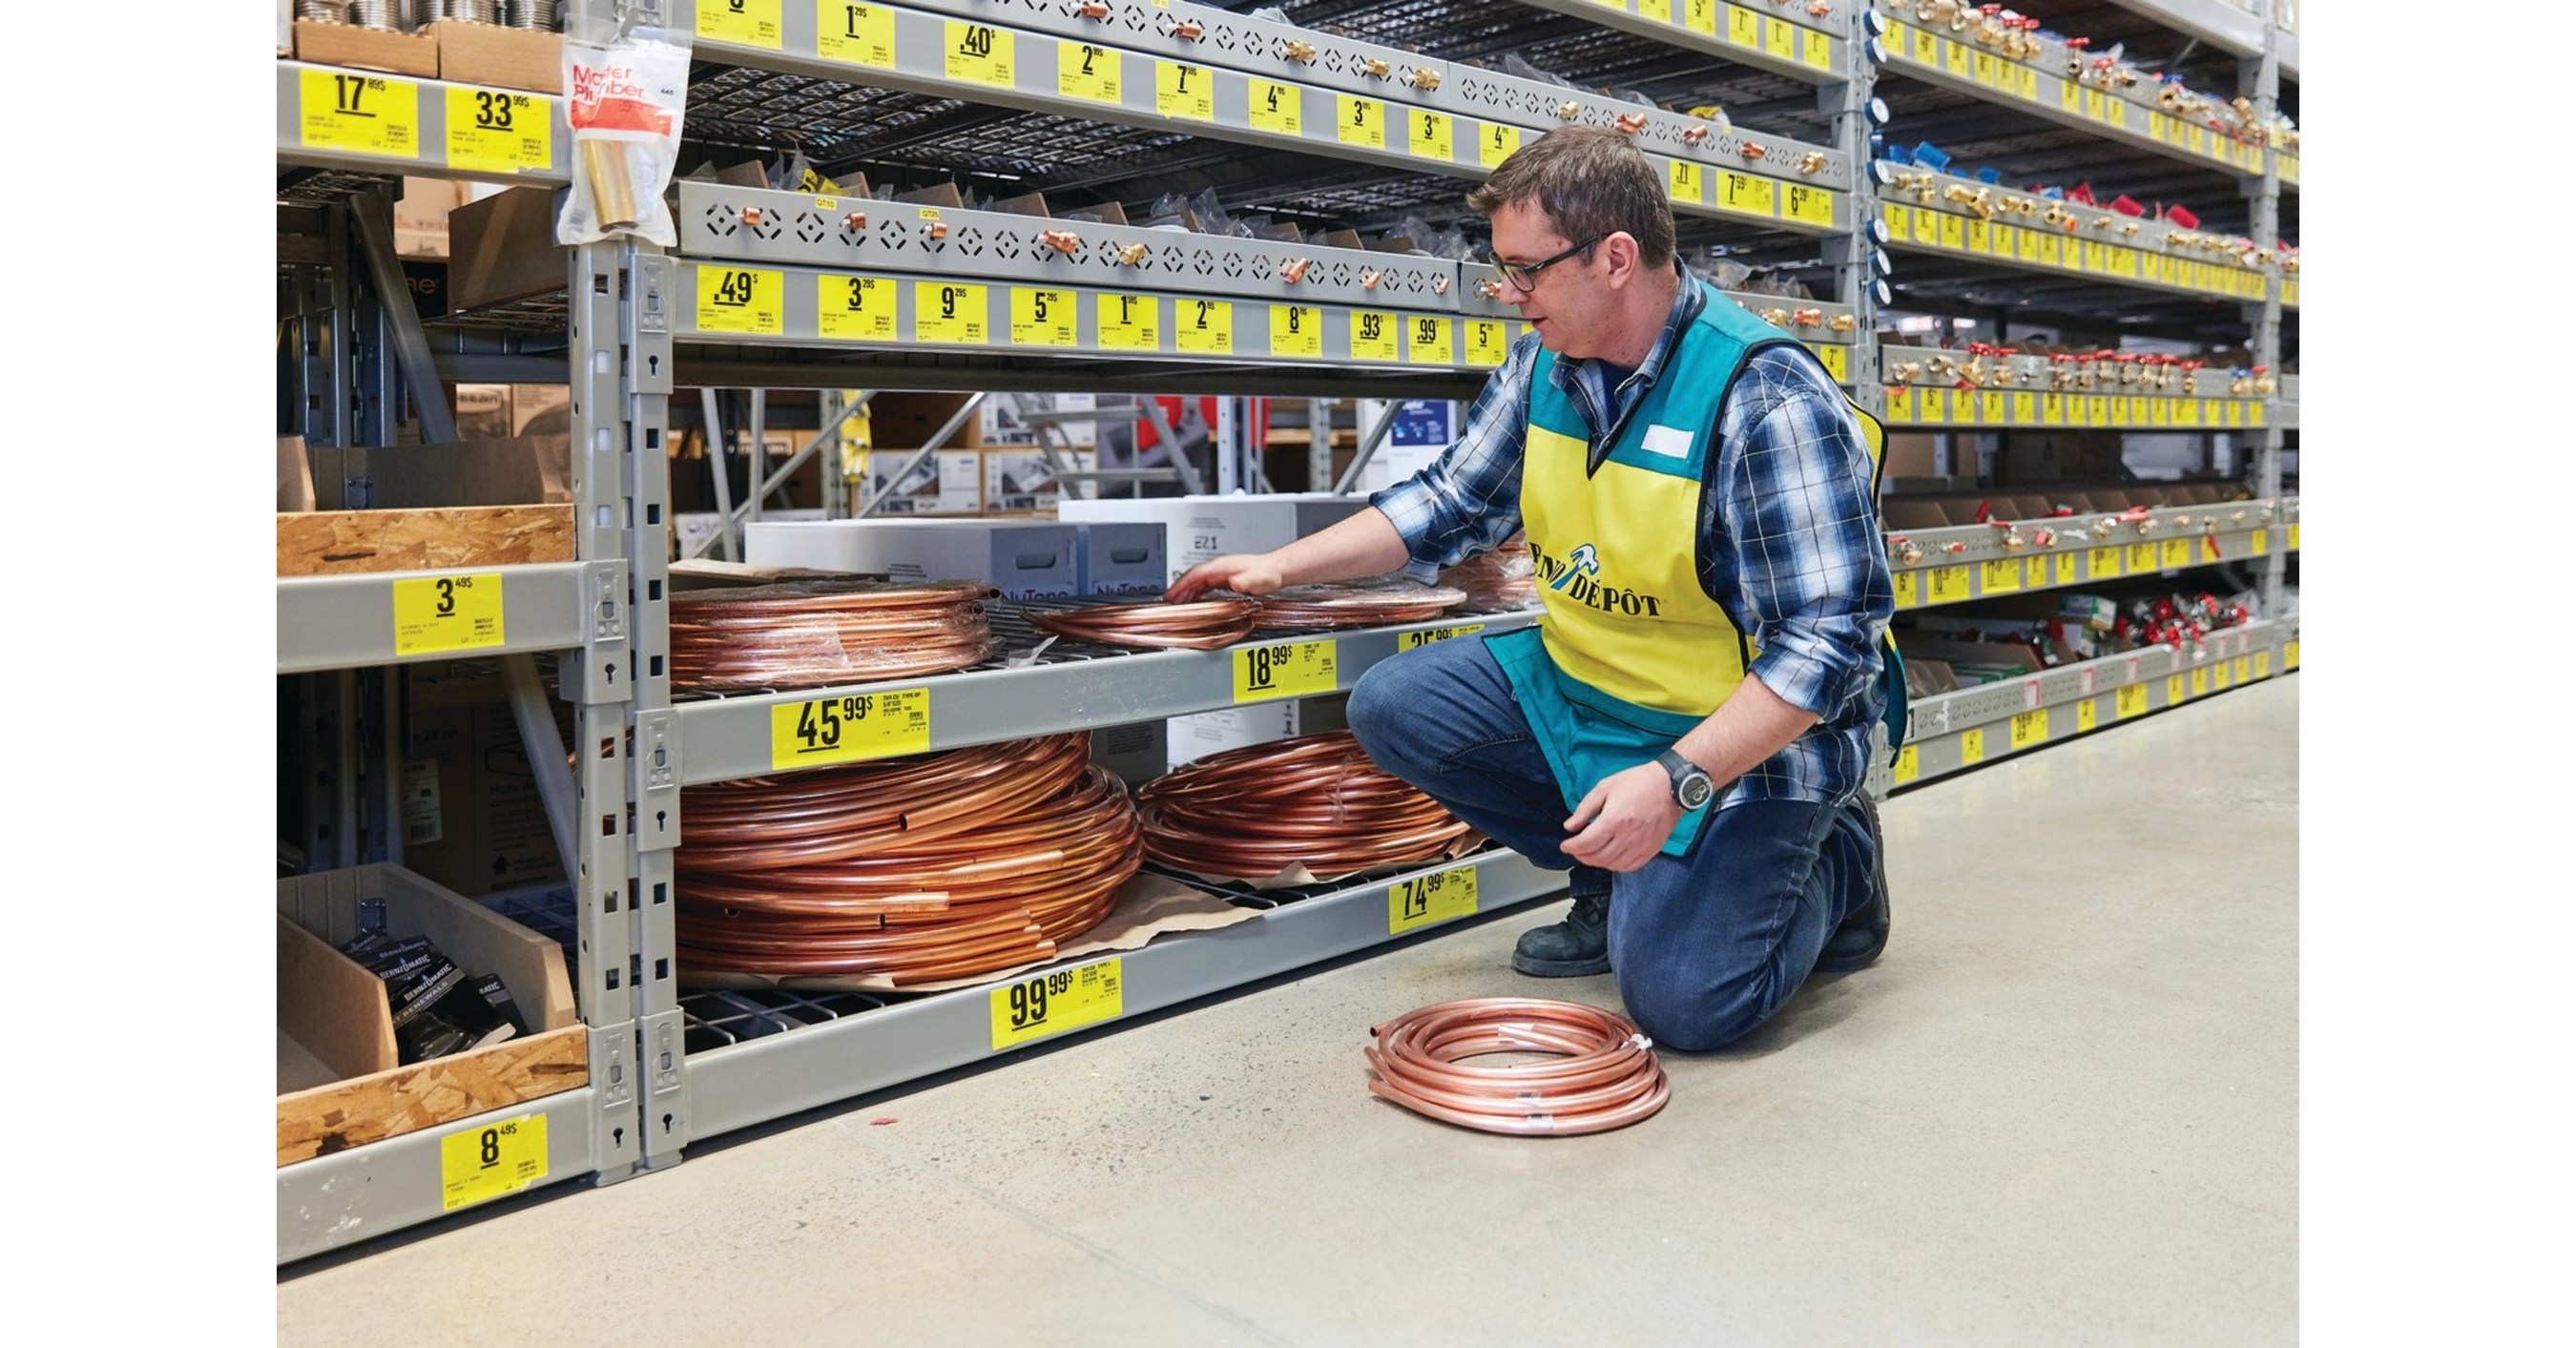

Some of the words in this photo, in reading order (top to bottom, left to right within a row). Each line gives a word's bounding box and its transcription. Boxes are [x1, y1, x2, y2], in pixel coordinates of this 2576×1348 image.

[846, 5, 855, 33] 1
[1082, 45, 1092, 72] 2
[573, 65, 633, 86] Mater
[335, 74, 365, 111] 17
[1267, 85, 1278, 108] 4
[476, 91, 512, 127] 33
[1354, 99, 1364, 123] 3
[1424, 114, 1433, 136] 3
[1494, 125, 1503, 146] 4
[1791, 187, 1798, 212] 6
[848, 278, 862, 306] 3
[942, 286, 954, 316] 9
[1035, 292, 1047, 319] 5
[1121, 295, 1128, 321] 1
[1196, 301, 1207, 324] 2
[1290, 306, 1298, 330] 8
[1480, 322, 1487, 344] 5
[436, 578, 455, 612] 3
[1568, 573, 1661, 616] DÉPÔT
[1247, 647, 1271, 687] 18
[1272, 645, 1293, 666] 99$
[797, 699, 841, 747] 45
[843, 695, 873, 721] 99$
[1402, 878, 1427, 916] 74
[1427, 872, 1445, 893] 99$
[379, 953, 431, 980] BERNZOMATIC
[404, 963, 453, 1002] BERNZOMATIC
[403, 981, 449, 1018] RENEWALS
[1010, 978, 1047, 1027] 99
[1049, 969, 1074, 996] 99$
[481, 1128, 500, 1163] 8
